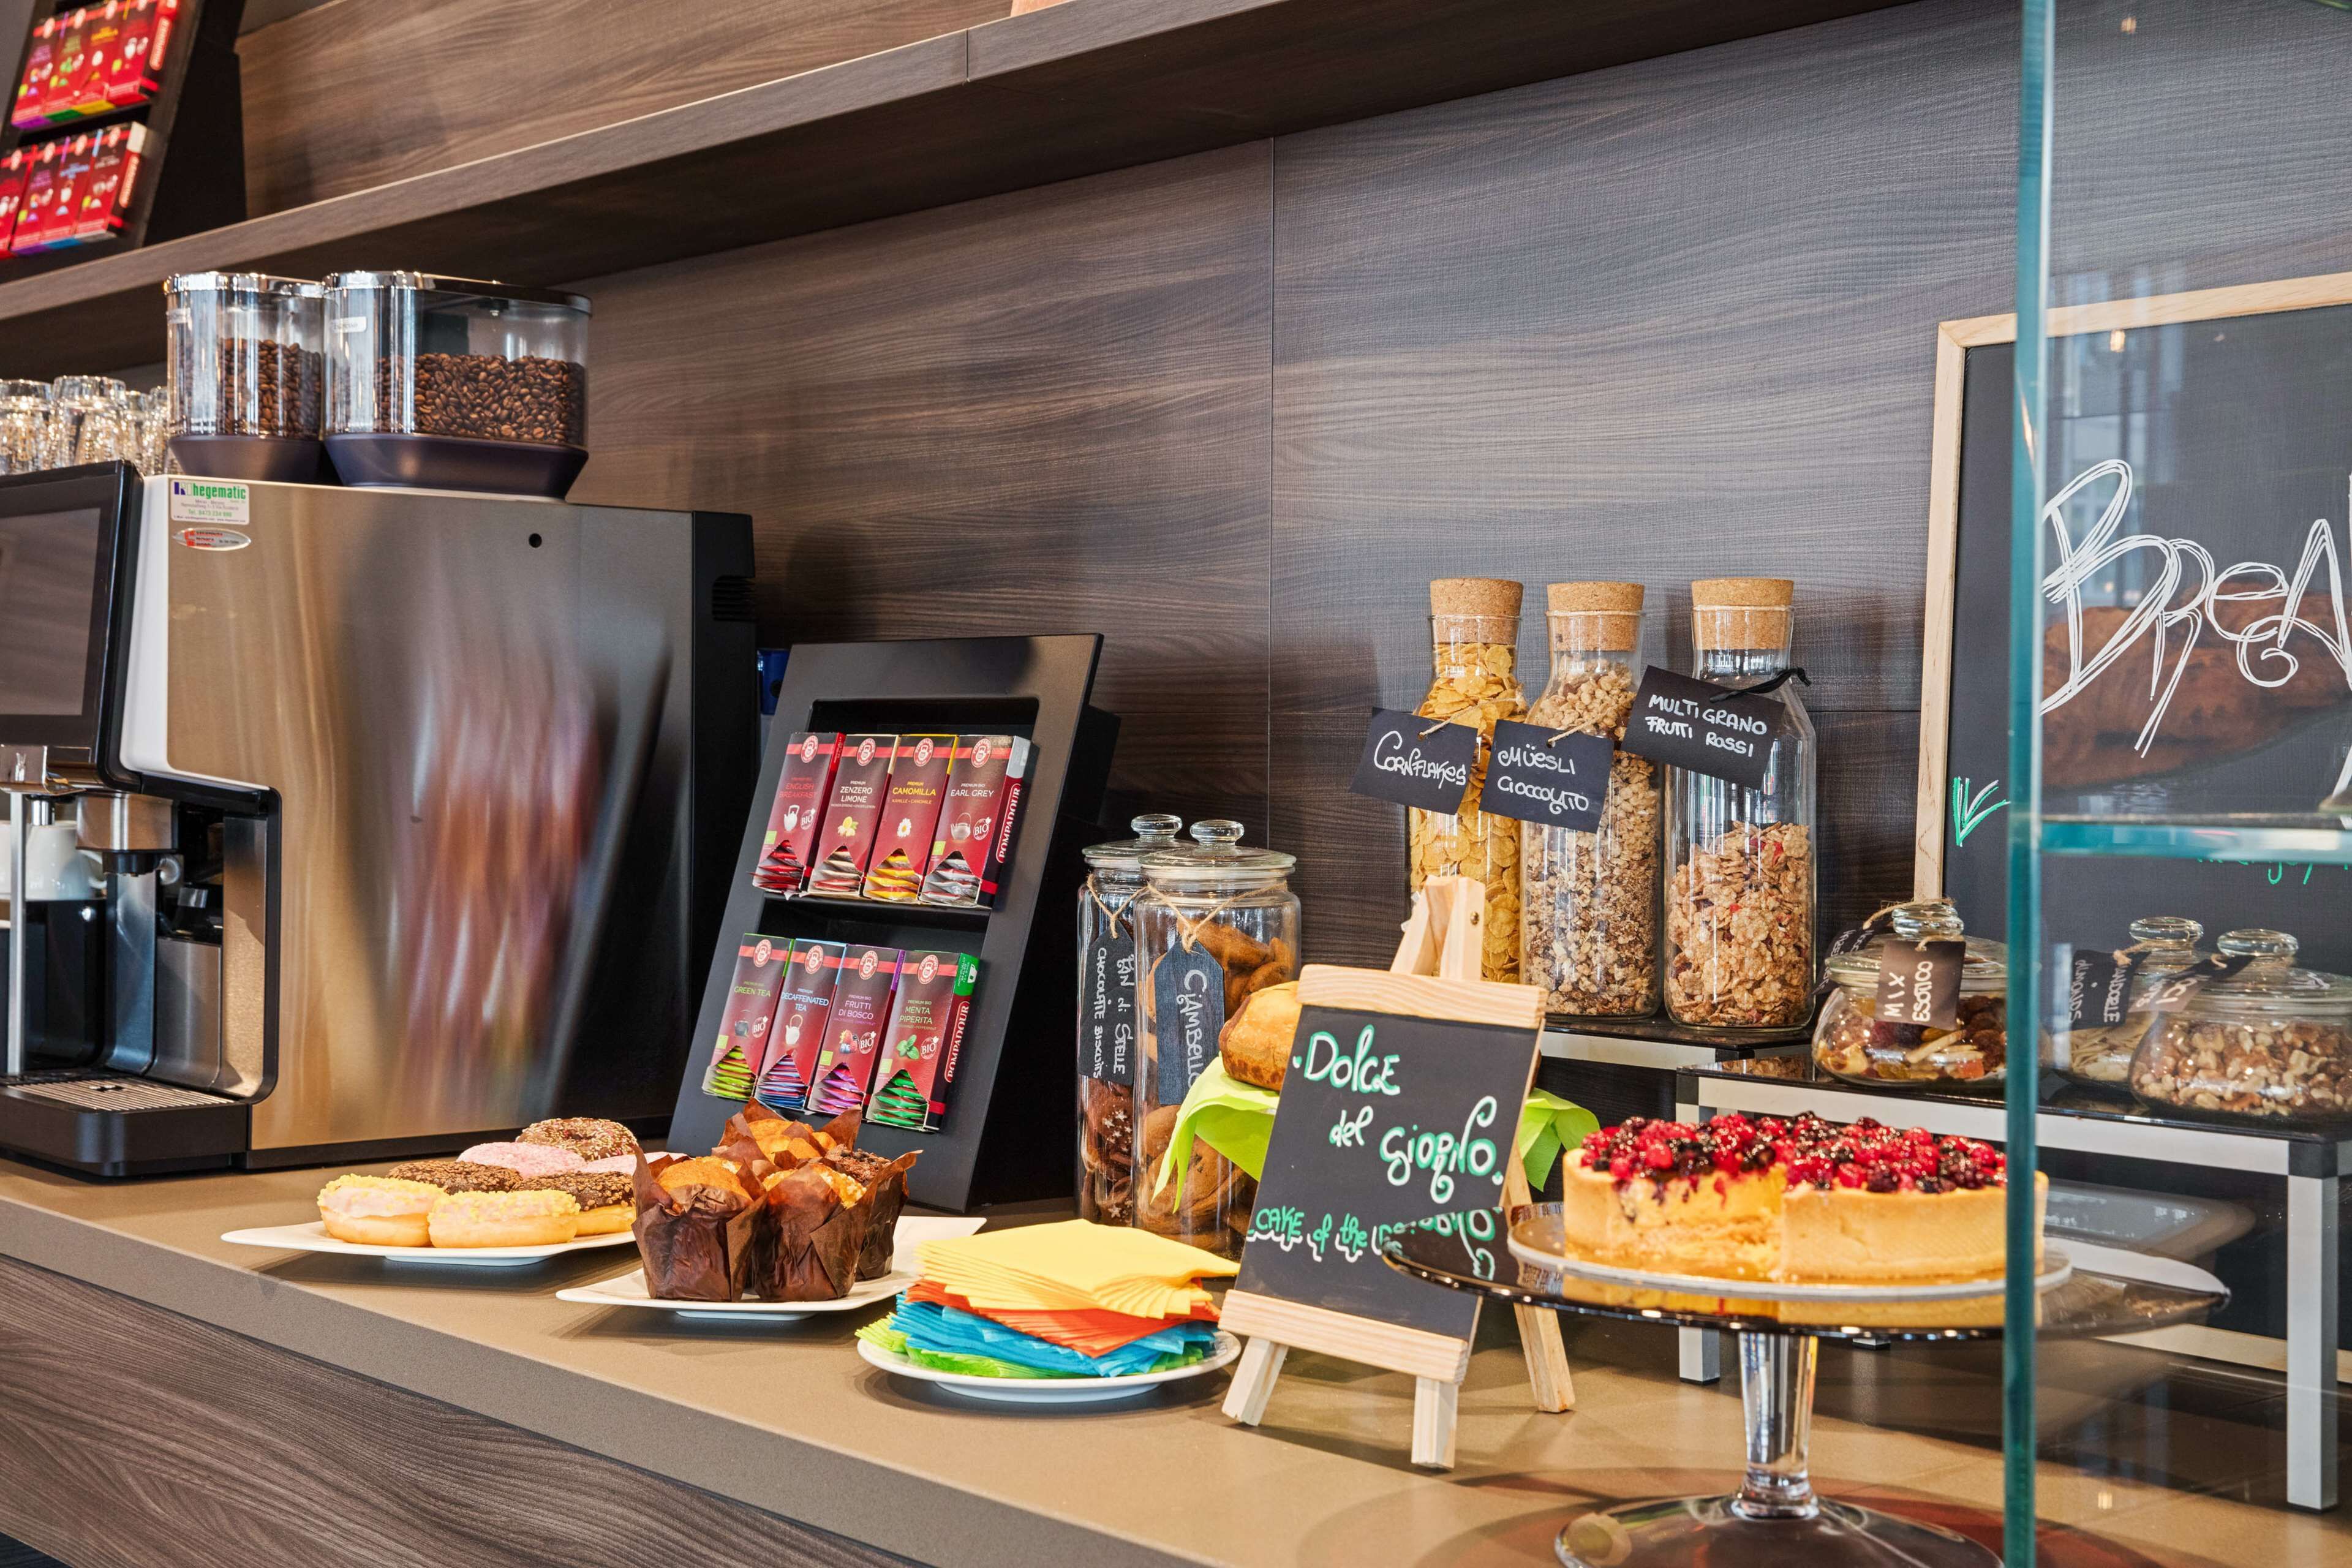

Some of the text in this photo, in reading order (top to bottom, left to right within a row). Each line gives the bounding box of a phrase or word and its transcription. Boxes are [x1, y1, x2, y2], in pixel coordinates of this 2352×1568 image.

[193, 483, 246, 499] hegematic
[1645, 716, 1754, 757] FRUTTI ROSSI
[892, 787, 936, 796] CAMOMILLA
[801, 814, 813, 825] BIO
[999, 788, 1020, 858] POMPADOUR
[974, 823, 989, 836] BIO
[734, 986, 771, 997] GREEN TEA
[1883, 972, 1905, 1017] MIX
[1912, 961, 1933, 1022] ESOTICO
[781, 992, 829, 1006] DECAFFEINATED
[845, 1000, 872, 1010] FRUTTI
[848, 1011, 873, 1020] BOSCO
[899, 1015, 933, 1025] PIPERITA
[1114, 954, 1135, 1074] PAN di STELLE
[753, 1022, 766, 1033] BIO
[861, 1038, 873, 1049] BIO
[948, 1005, 970, 1077] POMPADOUR
[922, 1044, 936, 1055] BIO
[1329, 1106, 1374, 1147] del
[1256, 1205, 1305, 1242] CAKE
[1313, 1213, 1332, 1253] of
[1340, 1213, 1368, 1253] the
